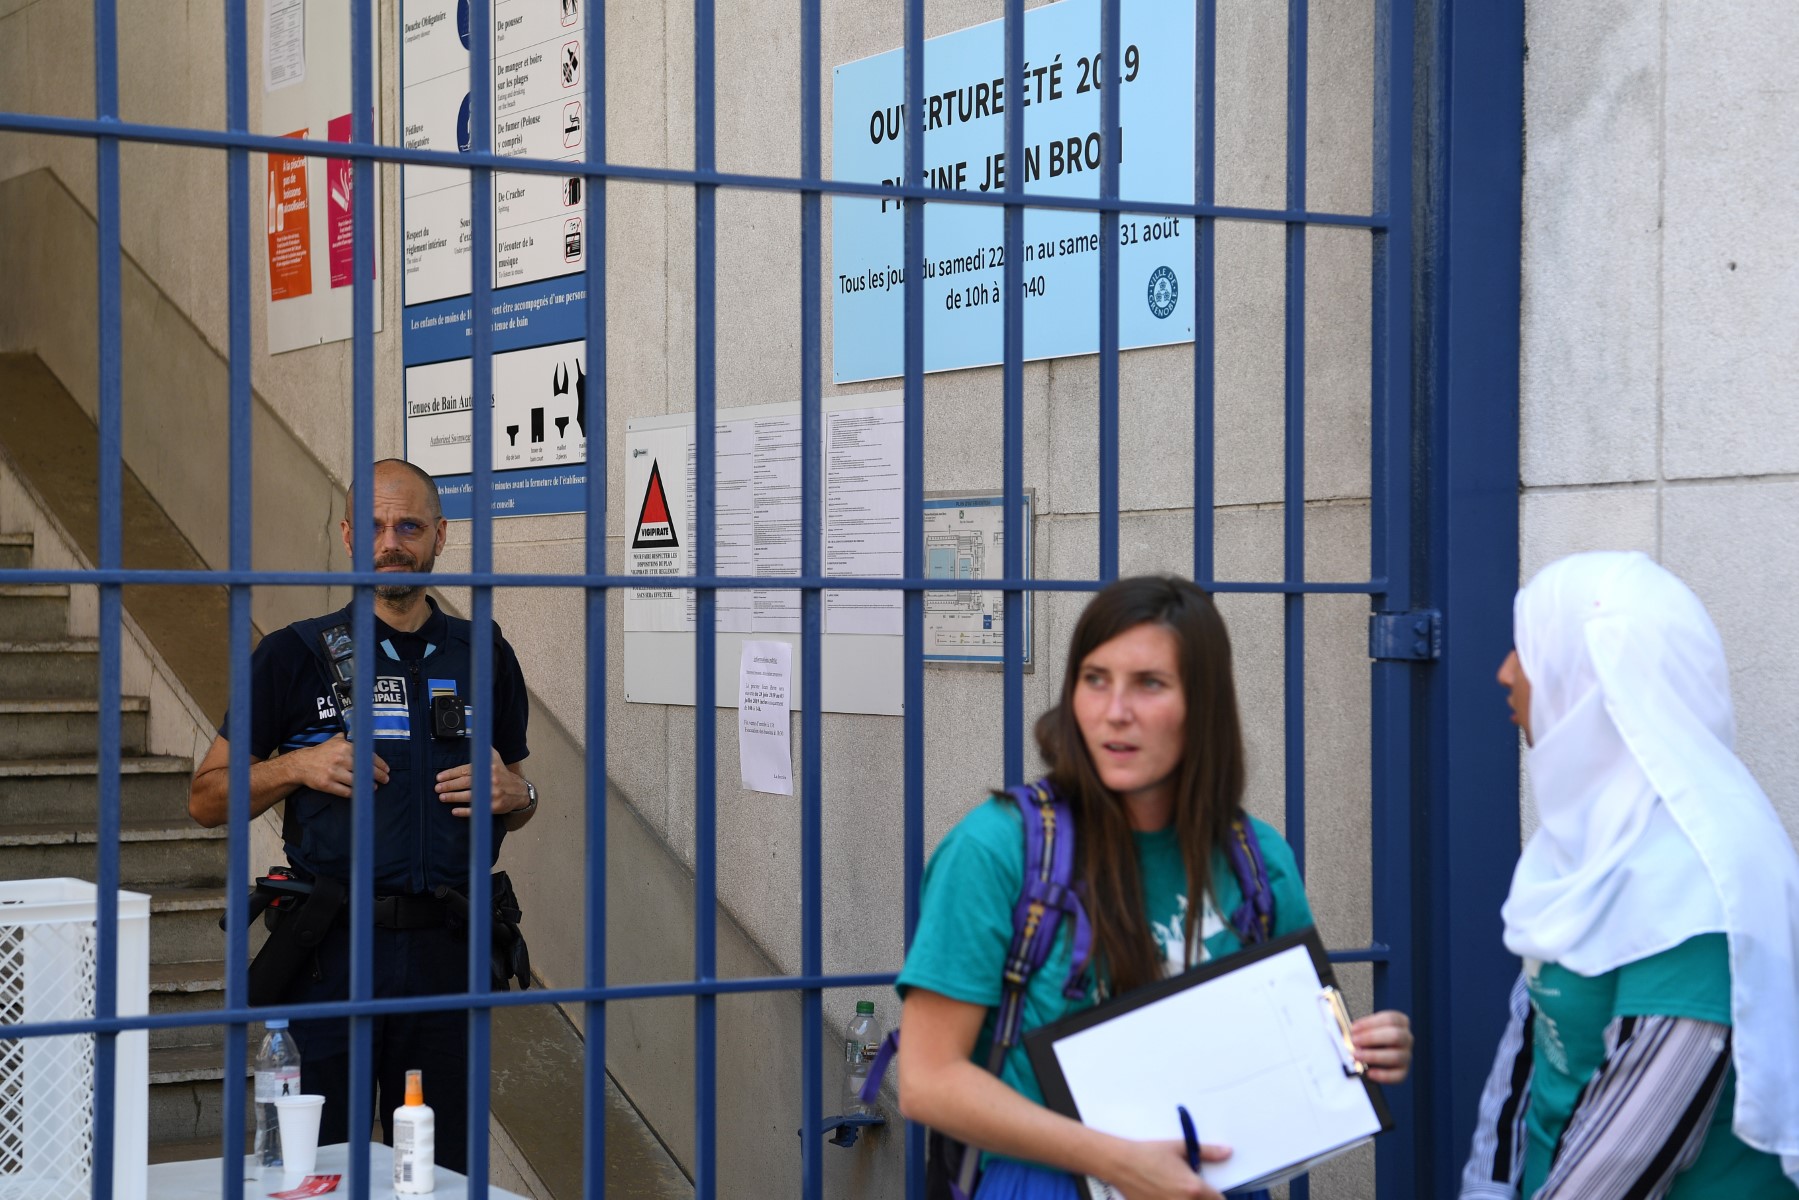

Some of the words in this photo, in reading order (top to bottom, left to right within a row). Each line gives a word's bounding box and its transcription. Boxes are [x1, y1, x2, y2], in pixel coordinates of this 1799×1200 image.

[405, 20, 420, 33] Douche
[422, 11, 446, 27] Obligatoire
[498, 21, 504, 31] De
[505, 16, 523, 31] pousser
[498, 66, 504, 75] De
[505, 61, 523, 72] manger
[524, 58, 528, 67] et
[530, 53, 542, 65] boire
[1076, 44, 1140, 94] 209
[514, 75, 528, 88] plages
[498, 124, 504, 134] De
[505, 122, 520, 132] fumer
[521, 116, 541, 129] (Pelouse
[406, 136, 430, 149] Obligatoire
[502, 134, 523, 148] compris)
[980, 145, 1040, 192] JEN
[1050, 127, 1123, 178] BRO
[499, 193, 505, 202] De
[506, 188, 525, 200] Cracher
[406, 229, 422, 241] Respect
[423, 226, 429, 237] du
[407, 242, 427, 256] règlement
[428, 238, 447, 250] intérieur
[499, 241, 521, 253] D'écouter
[522, 238, 528, 247] de
[529, 236, 534, 246] la
[499, 256, 518, 268] musique
[840, 274, 866, 294] Tous
[868, 268, 885, 290] les
[887, 265, 905, 292] jou
[938, 249, 986, 277] samedi
[988, 246, 1004, 269] 22
[1038, 240, 1055, 259] au
[1059, 233, 1099, 257] same
[1120, 222, 1138, 246] 31
[1143, 216, 1180, 241] août
[1150, 268, 1166, 287] VILLE
[1168, 272, 1177, 287] DE
[946, 288, 962, 311] de
[965, 284, 989, 308] 10h
[992, 281, 1000, 304] à
[1149, 291, 1177, 317] GRENOBLE
[411, 320, 419, 330] Les
[420, 317, 437, 328] enfants
[438, 315, 444, 325] de
[445, 312, 459, 323] moins
[460, 310, 466, 321] de
[503, 302, 514, 314] être
[514, 295, 548, 311] accompagnés
[549, 294, 564, 305] d'une
[495, 322, 508, 331] tenue
[509, 318, 516, 328] de
[517, 316, 528, 327] bain
[408, 401, 430, 415] Tenues
[432, 397, 441, 412] de
[442, 395, 457, 411] Bain
[445, 485, 459, 495] bassins
[495, 481, 512, 491] minutes
[512, 480, 524, 489] avant
[525, 479, 530, 488] la
[530, 478, 552, 488] fermeture
[553, 476, 559, 486] de
[641, 527, 669, 537] VIGIPIRATE
